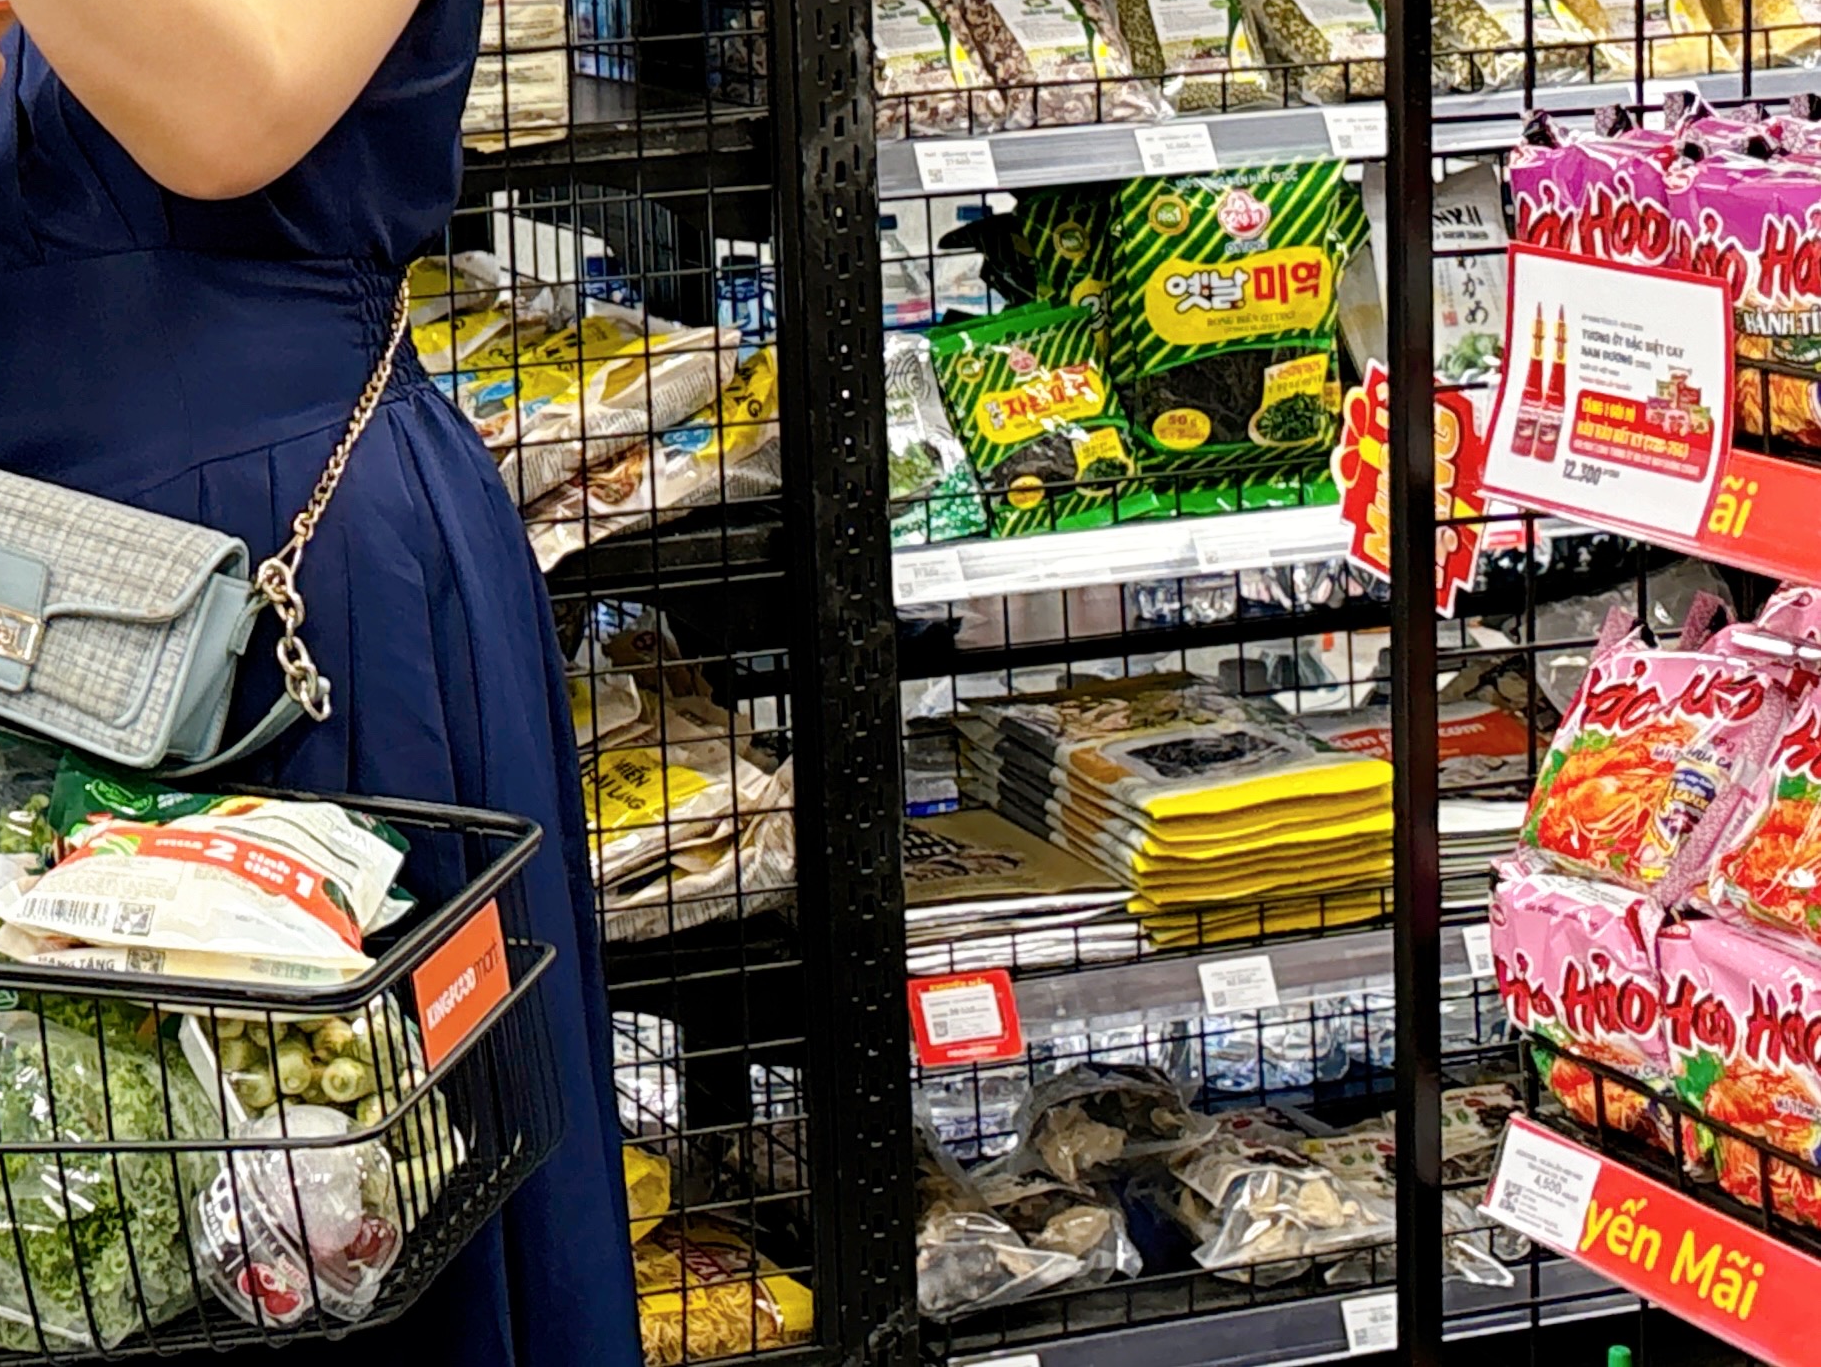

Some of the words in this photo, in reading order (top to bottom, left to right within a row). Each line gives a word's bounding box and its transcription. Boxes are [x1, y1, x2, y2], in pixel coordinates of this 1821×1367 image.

[1708, 475, 1759, 539] ãi
[203, 838, 239, 863] 2
[294, 871, 316, 900] 1
[1580, 1198, 1662, 1271] yến
[1670, 1229, 1765, 1321] Mãi
